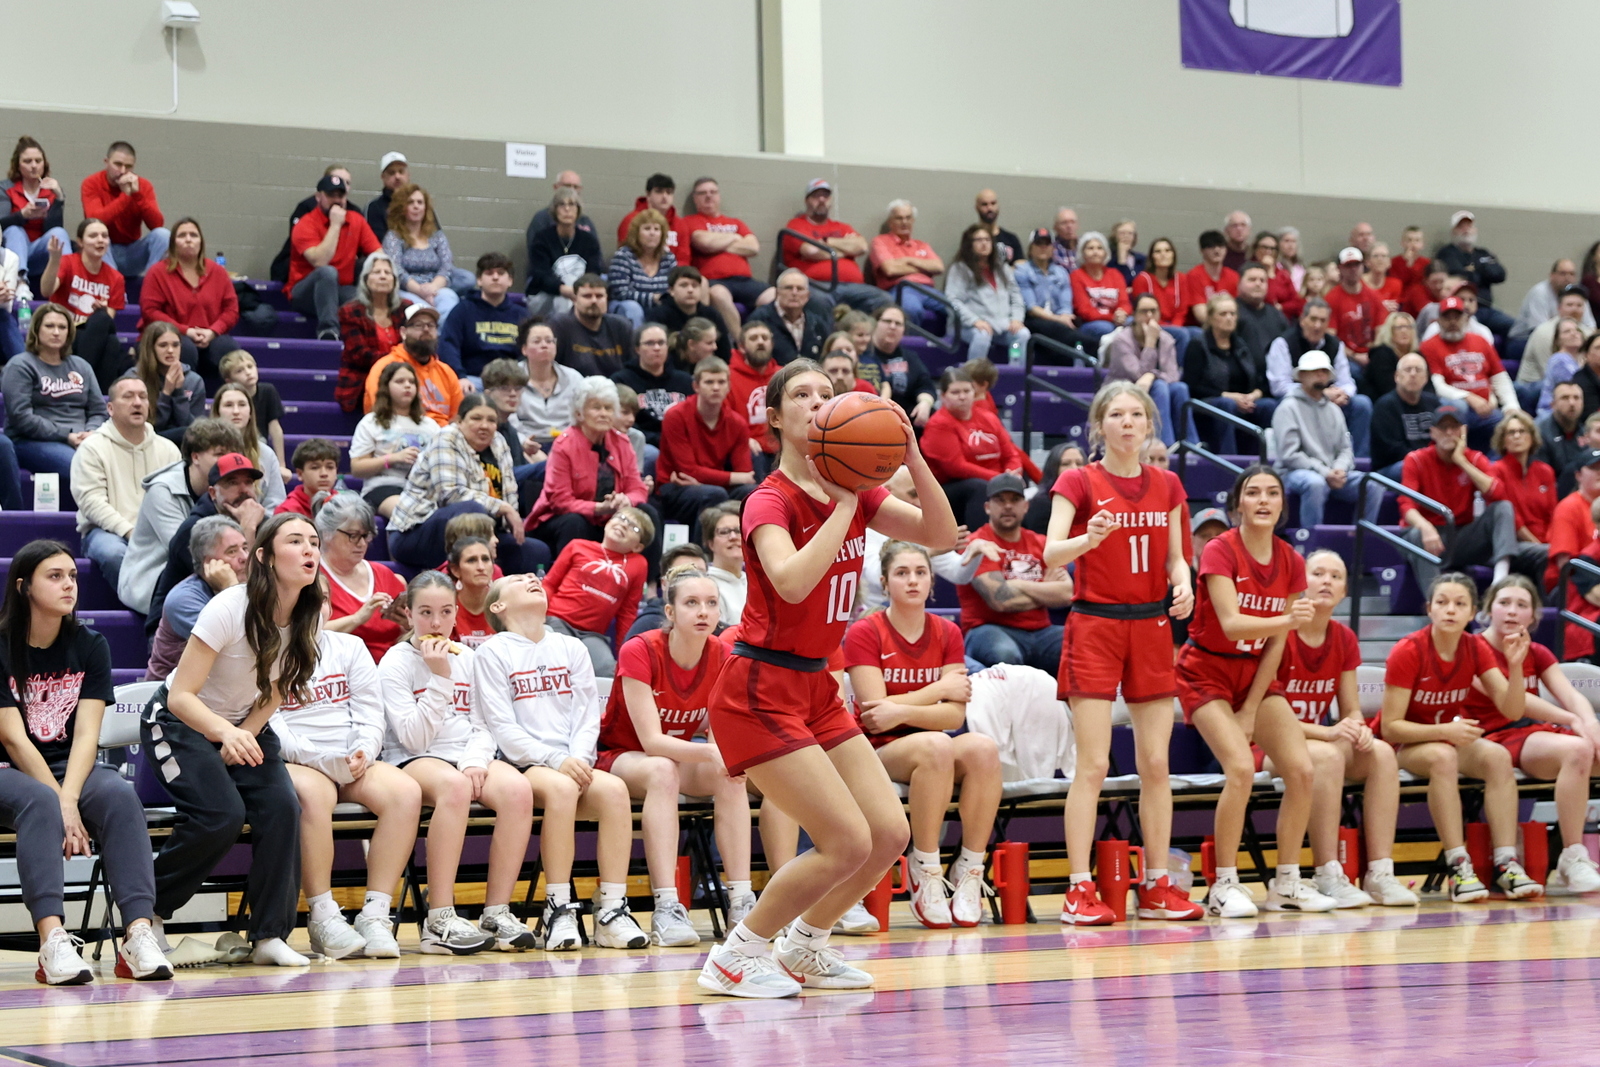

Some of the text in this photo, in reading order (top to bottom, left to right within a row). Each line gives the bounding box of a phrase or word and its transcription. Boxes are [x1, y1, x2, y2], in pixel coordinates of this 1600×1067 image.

[1115, 511, 1168, 528] ELLEVUE
[1129, 534, 1149, 574] 11
[826, 571, 857, 624] 10
[1237, 591, 1287, 613] BELLEVU
[883, 667, 943, 684] BELLEVU
[511, 673, 572, 698] BELLEVU
[1286, 678, 1336, 694] ELLEVUE
[1414, 686, 1470, 705] BELLEVU
[115, 703, 147, 713] BLU
[660, 707, 707, 723] ELLEVU
